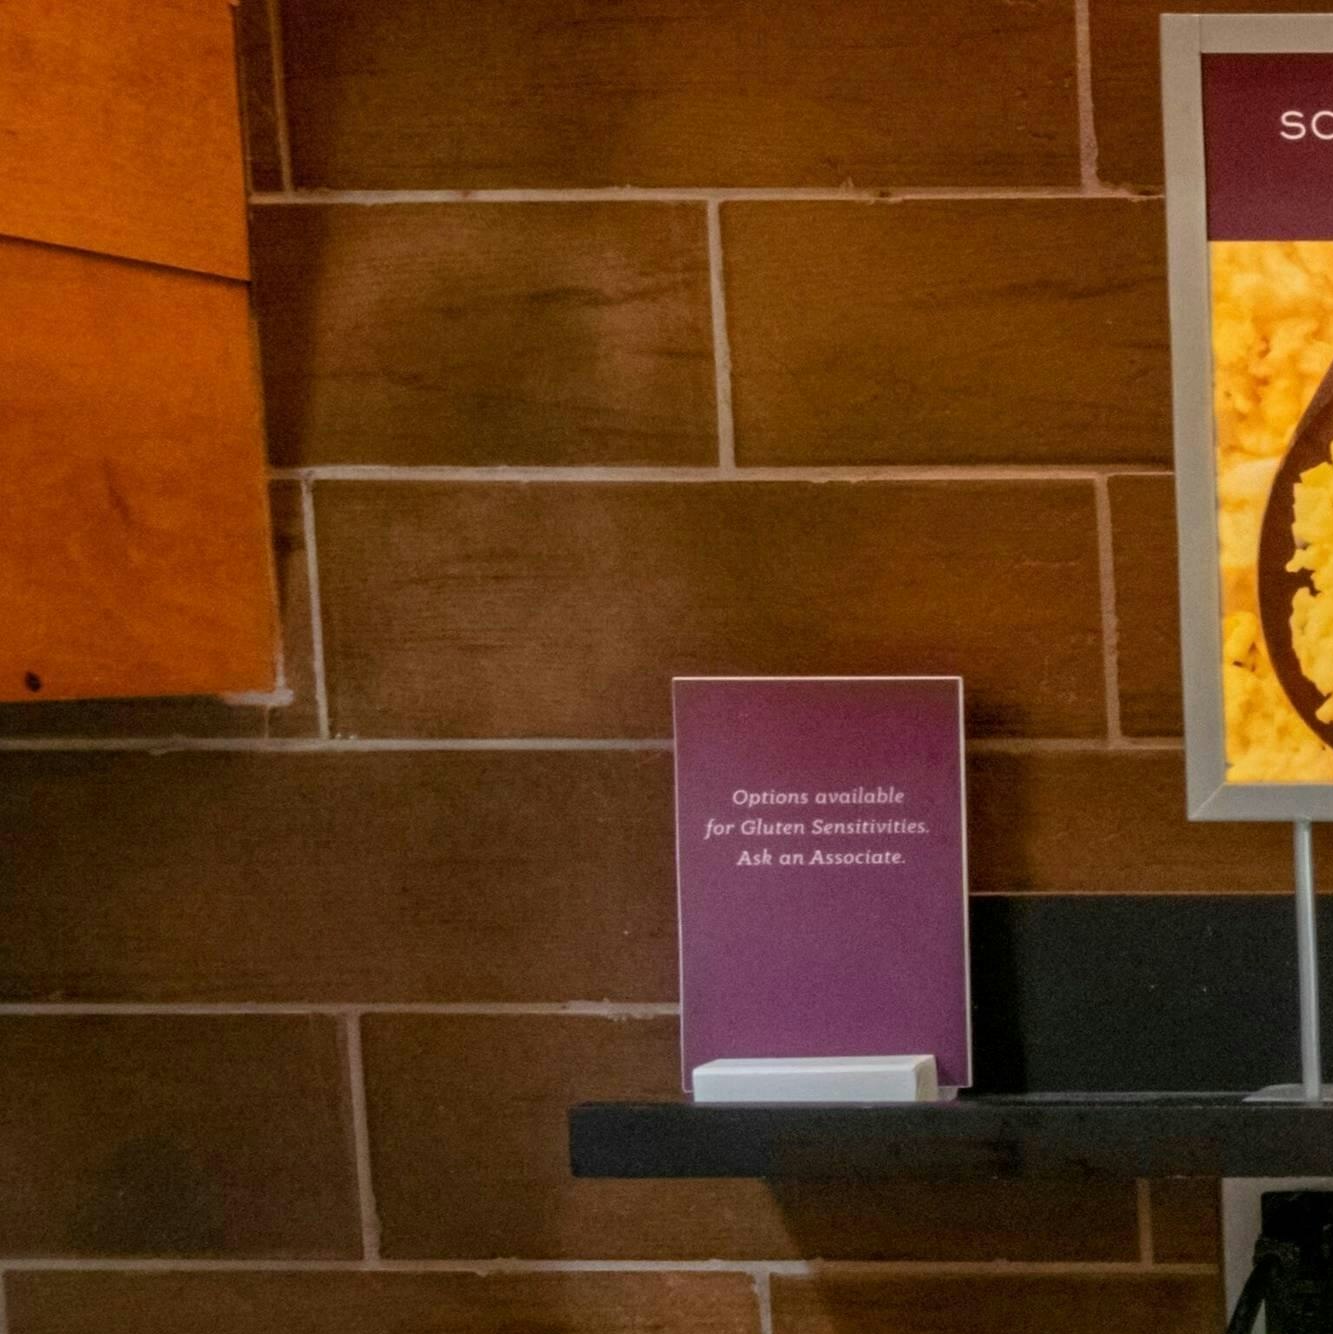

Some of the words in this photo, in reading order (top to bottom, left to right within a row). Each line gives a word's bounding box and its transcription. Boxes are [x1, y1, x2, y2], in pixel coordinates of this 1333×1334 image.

[732, 788, 809, 808] Options
[814, 786, 905, 804] available
[704, 818, 735, 840] for
[740, 818, 805, 836] Gluten
[811, 818, 930, 835] Sensitivities.
[736, 848, 772, 866] Ask
[778, 853, 805, 866] an
[808, 848, 906, 866] Associate.
